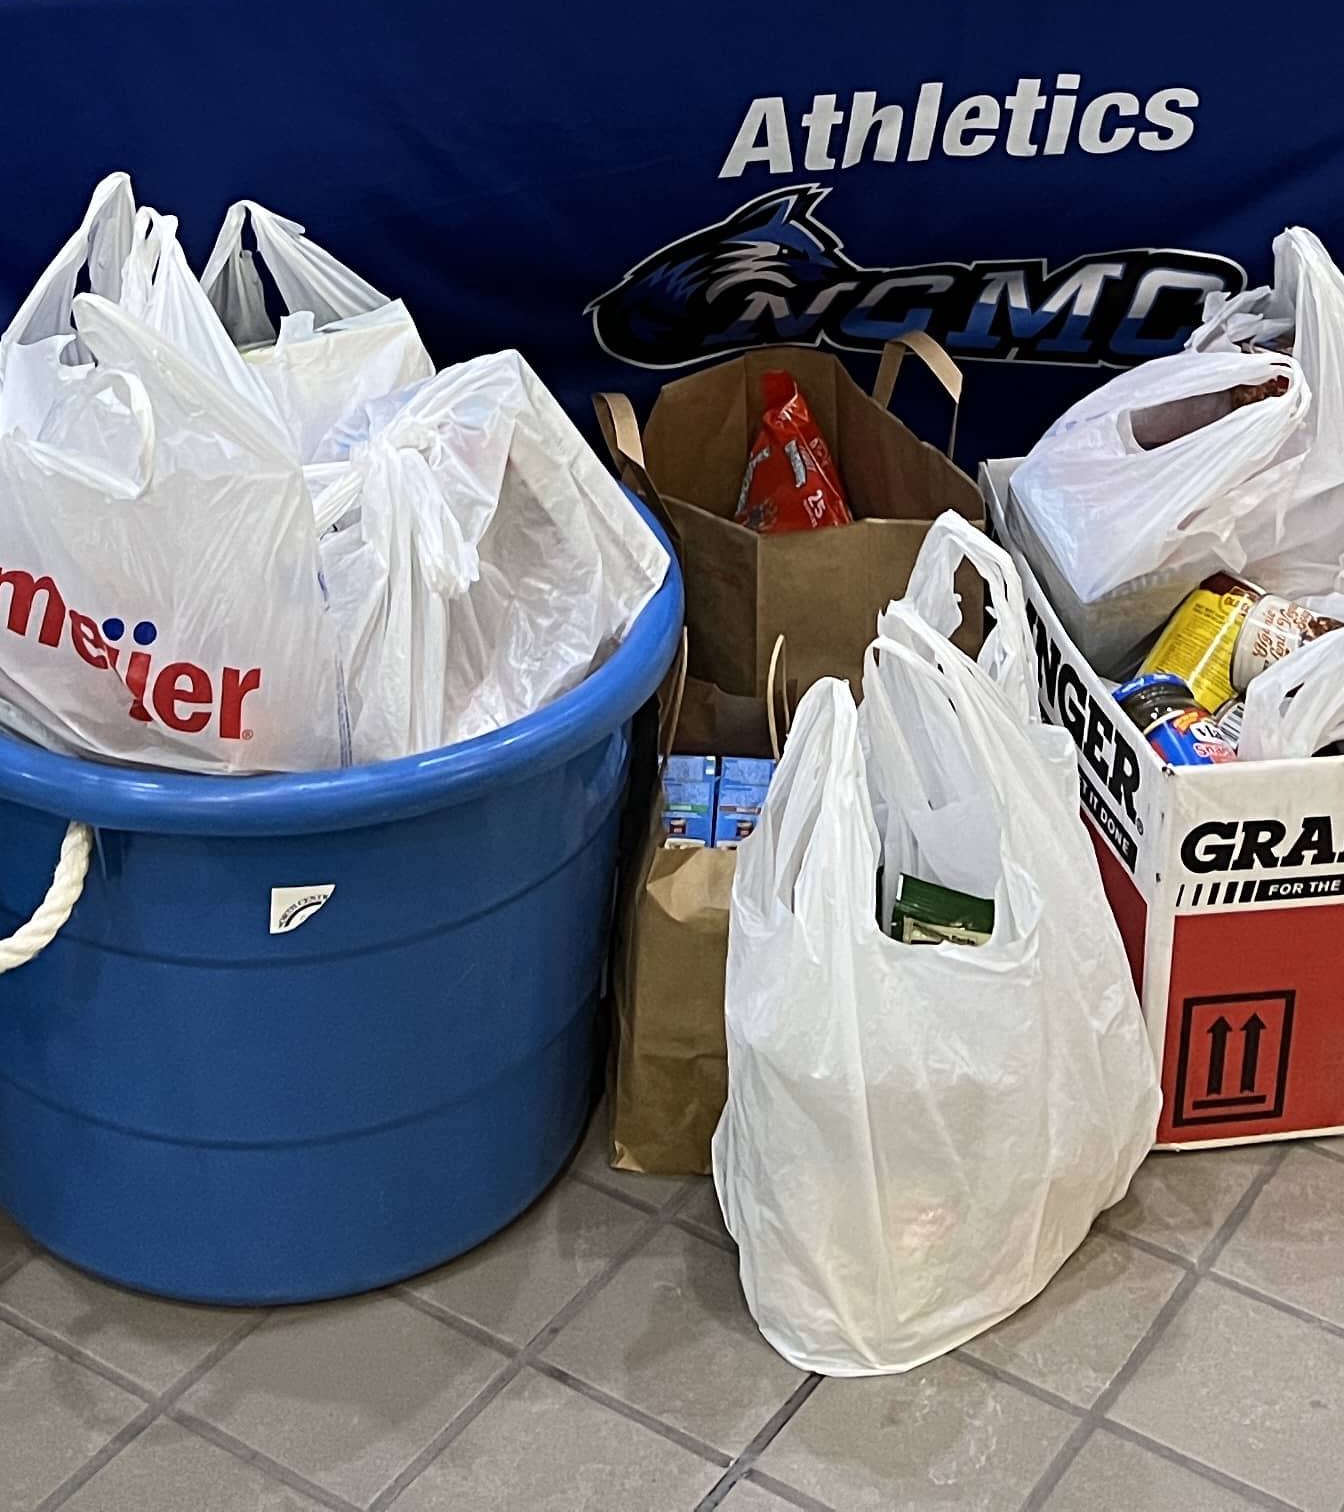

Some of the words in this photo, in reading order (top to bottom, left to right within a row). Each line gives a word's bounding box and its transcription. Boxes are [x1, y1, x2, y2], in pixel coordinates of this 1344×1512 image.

[717, 72, 1200, 179] Athletics
[706, 262, 1230, 356] NCMC
[807, 488, 826, 519] 25
[1089, 790, 1099, 810] IT
[1100, 806, 1131, 857] DONE
[1269, 882, 1304, 896] FOR
[1309, 879, 1340, 893] THE
